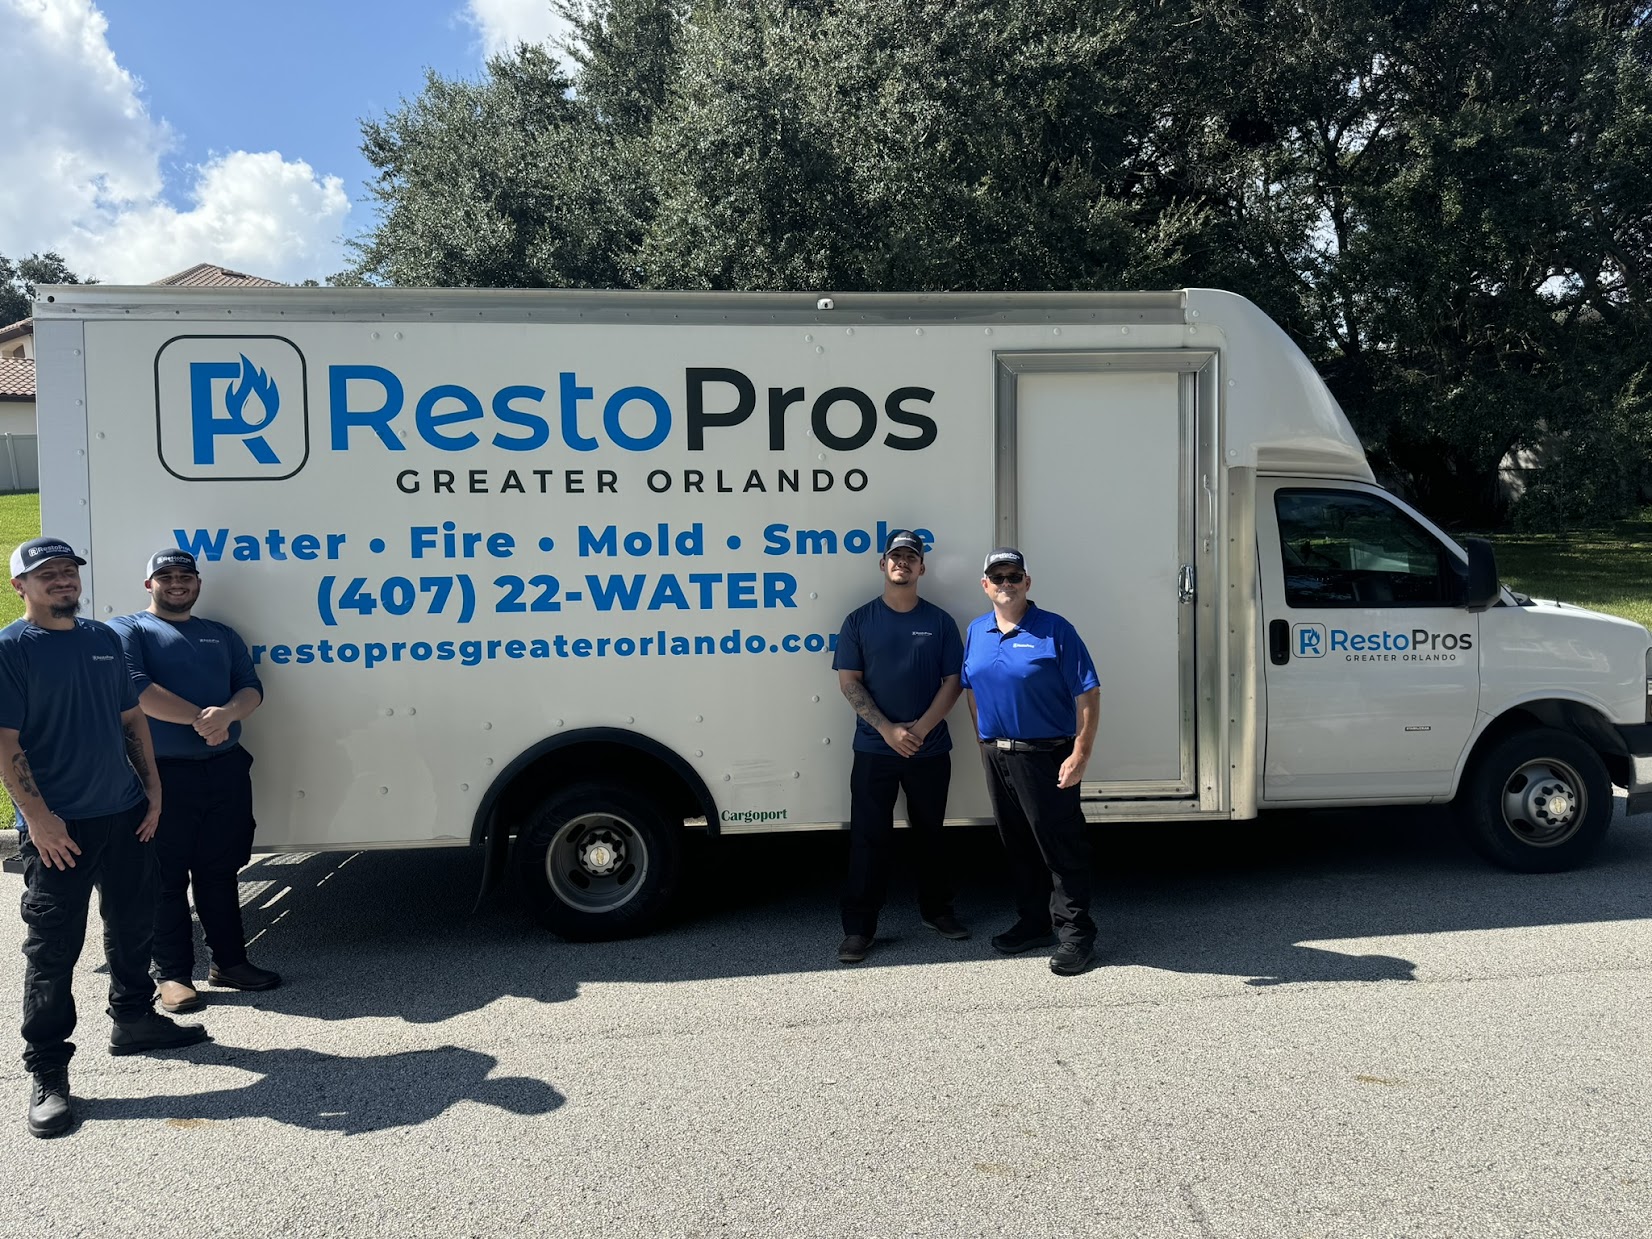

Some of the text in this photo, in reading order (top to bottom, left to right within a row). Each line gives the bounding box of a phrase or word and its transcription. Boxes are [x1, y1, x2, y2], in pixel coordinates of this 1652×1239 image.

[329, 364, 938, 452] RestoPros
[396, 468, 869, 494] GREATER ORLANDO
[173, 527, 347, 563] Water
[410, 521, 516, 560] Fire
[577, 522, 705, 559] Mold
[317, 572, 798, 627] (407) 22-WATER
[1330, 629, 1473, 651] RestoPros
[1345, 653, 1457, 662] GREATER ORLANDO
[721, 808, 788, 823] Cargoport
